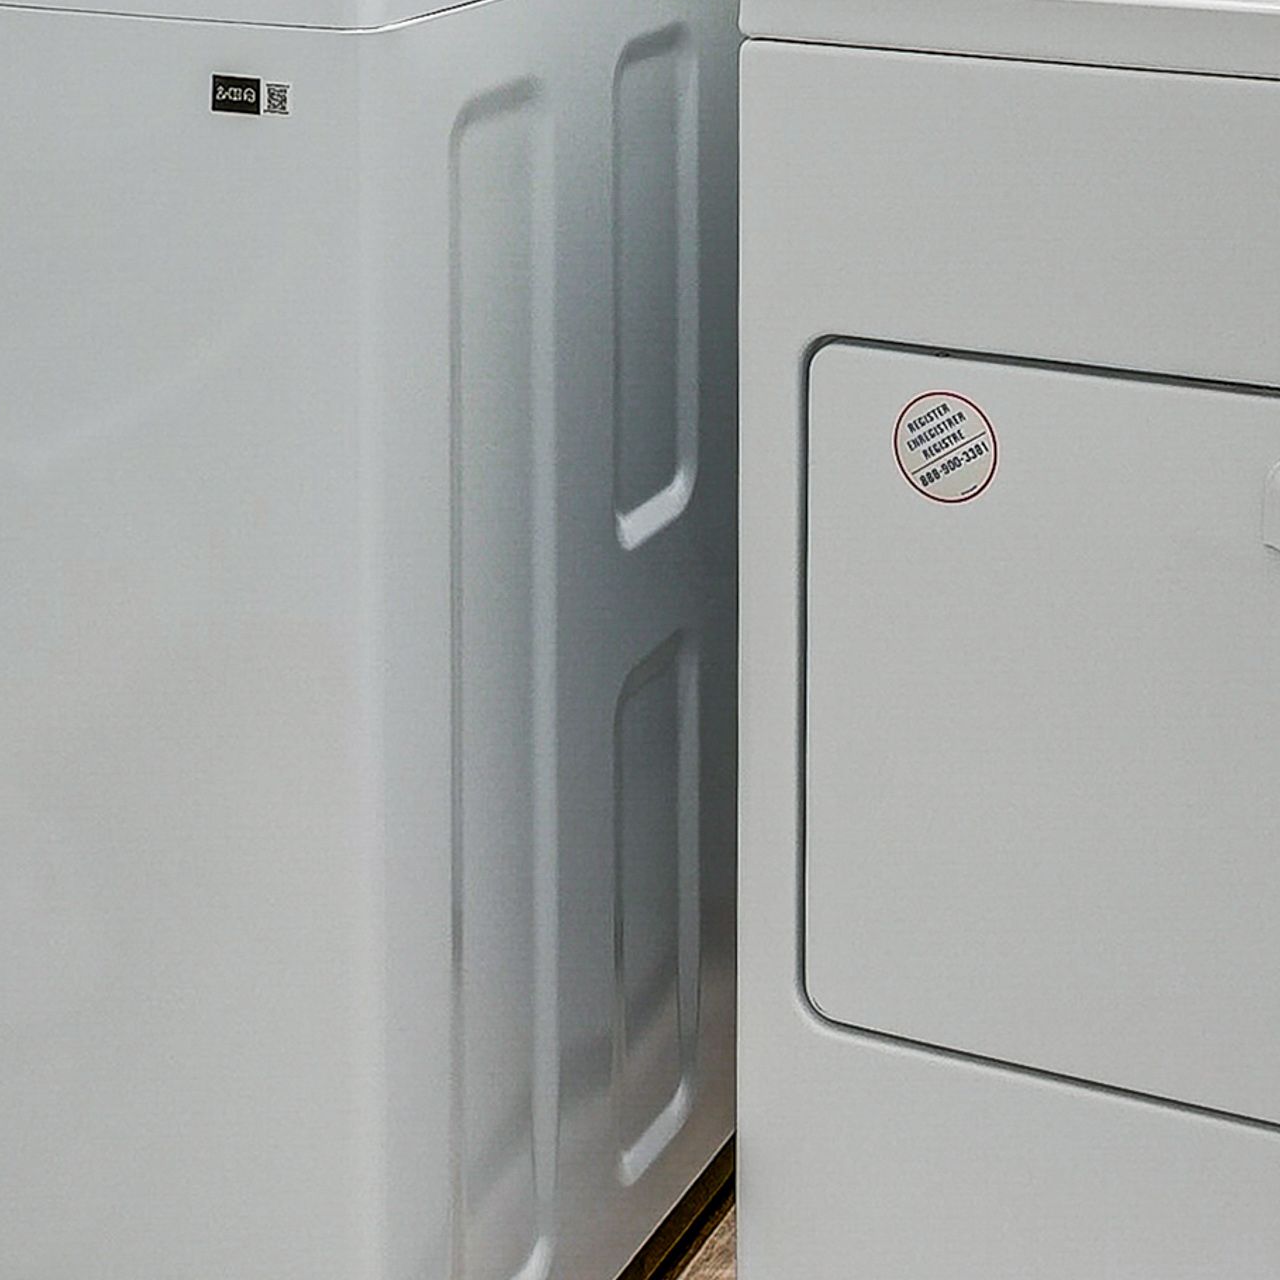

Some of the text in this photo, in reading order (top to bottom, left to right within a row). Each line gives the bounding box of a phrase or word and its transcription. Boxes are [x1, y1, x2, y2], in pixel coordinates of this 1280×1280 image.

[907, 403, 950, 434] REGISTER
[907, 411, 966, 451] ENREGISTRER
[919, 441, 989, 487] 888-900-3381
